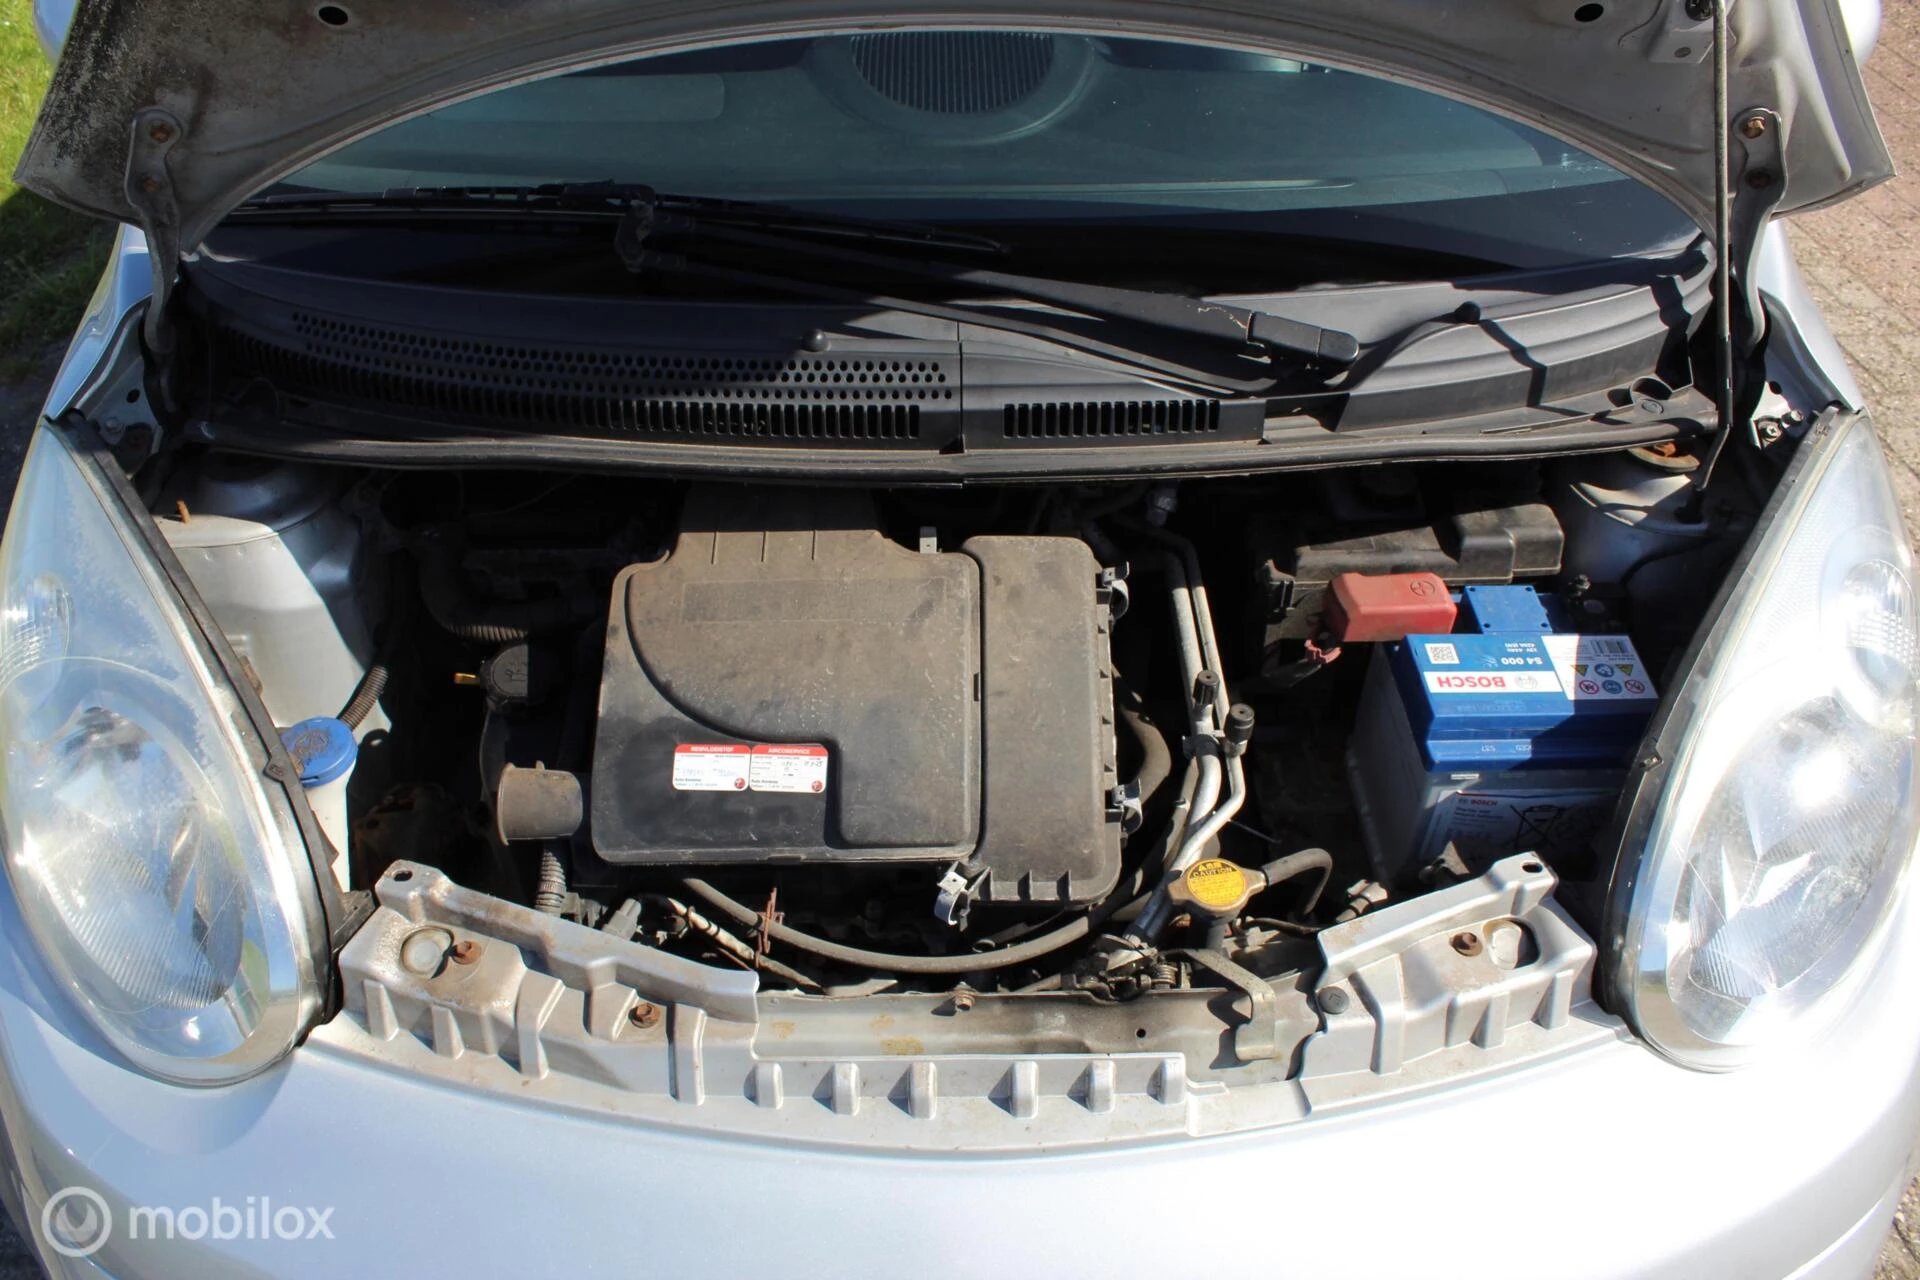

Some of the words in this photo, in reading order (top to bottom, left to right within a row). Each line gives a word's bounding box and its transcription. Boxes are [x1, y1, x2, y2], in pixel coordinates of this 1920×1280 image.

[1501, 656, 1525, 665] 000
[1526, 656, 1544, 665] S4
[1436, 676, 1506, 689] BOSCH
[1192, 867, 1233, 877] CAUTION
